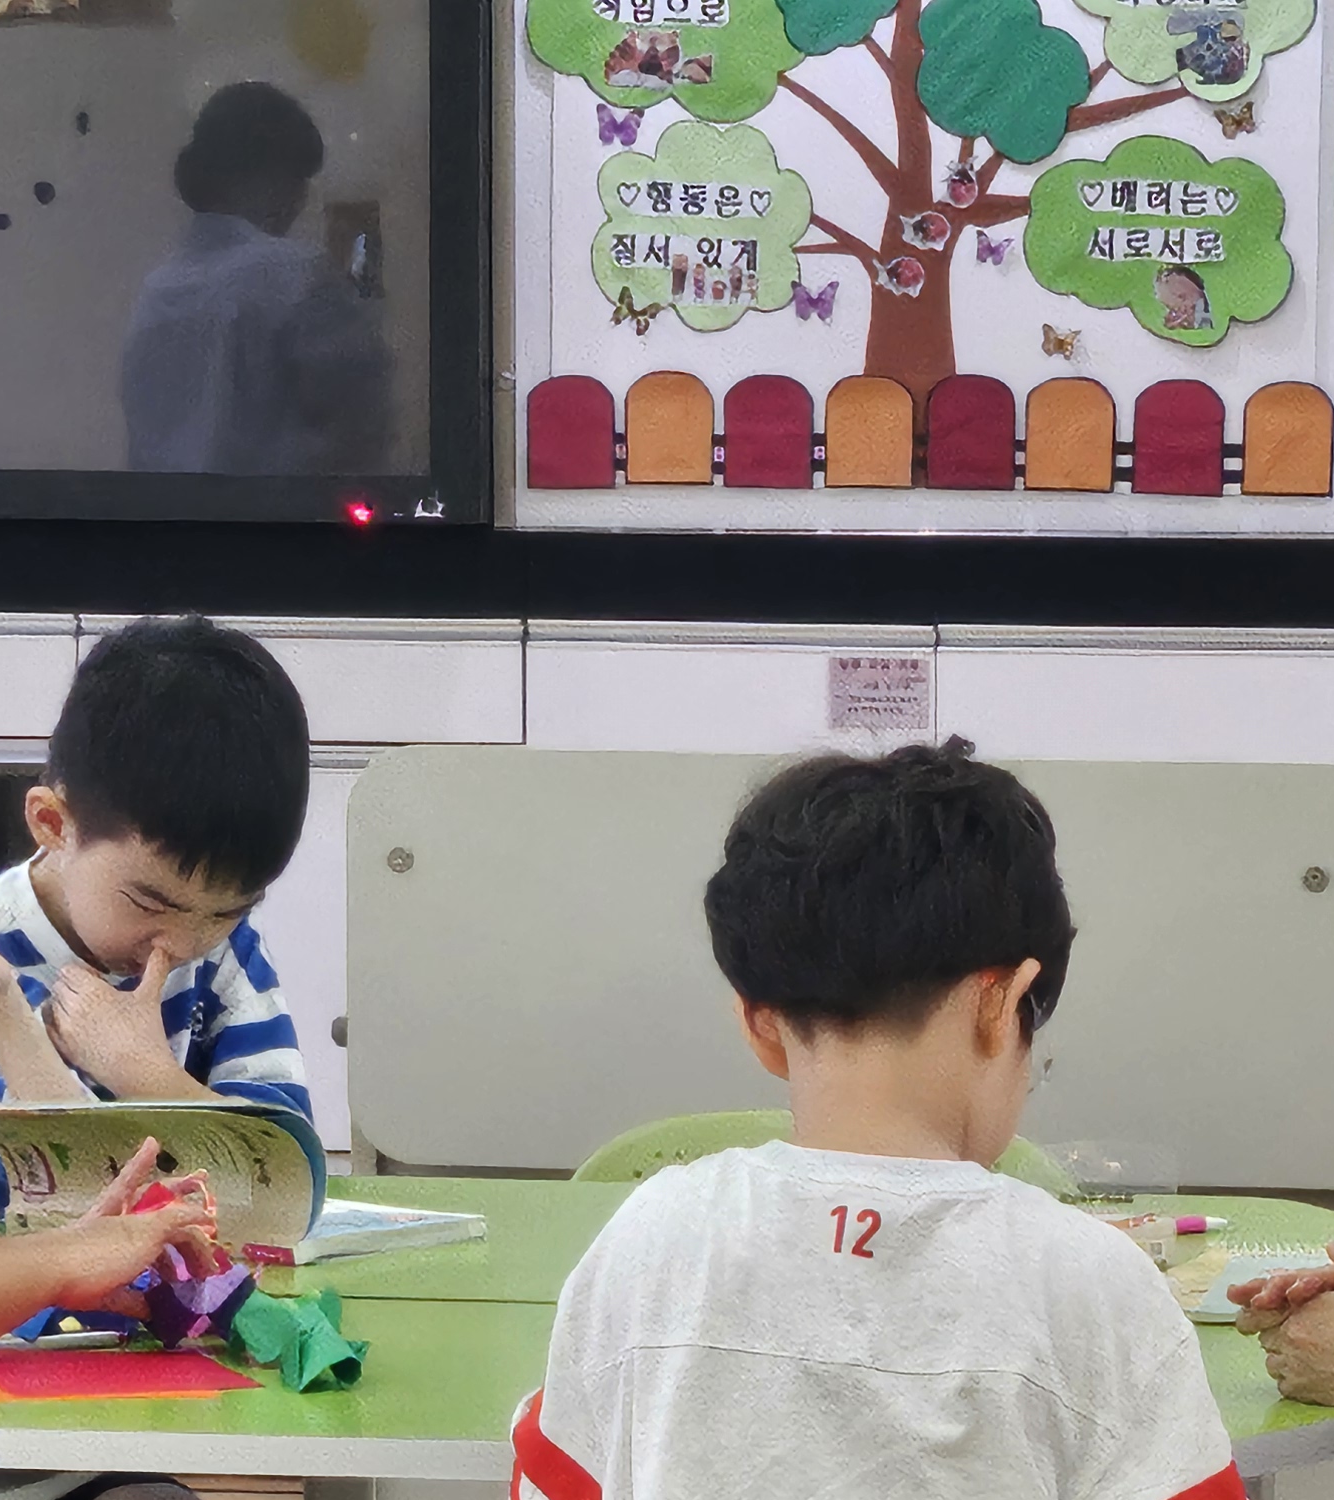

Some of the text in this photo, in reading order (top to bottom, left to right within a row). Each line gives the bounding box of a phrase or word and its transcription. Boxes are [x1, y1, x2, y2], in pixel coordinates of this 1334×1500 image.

[1111, 180, 1208, 215] 배려는
[610, 234, 758, 272] 질서 있게
[1087, 227, 1222, 262] 서로서로
[829, 1205, 882, 1259] 12
